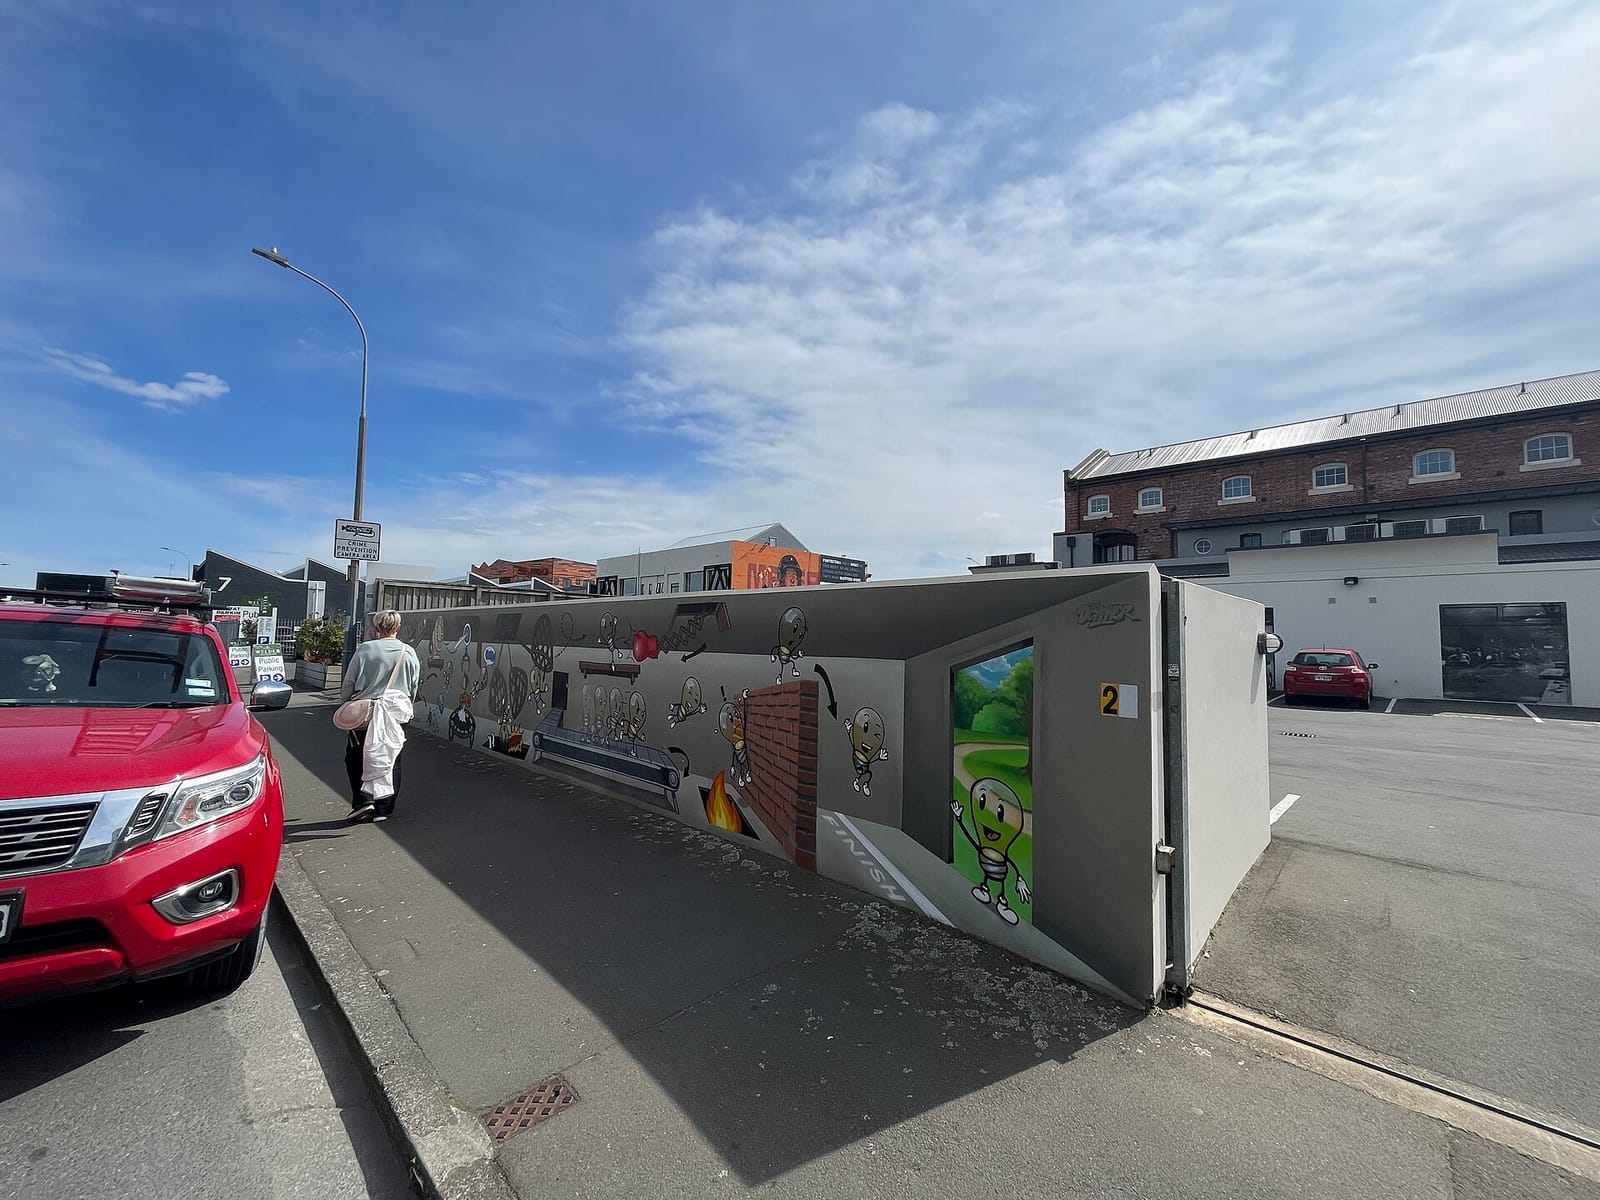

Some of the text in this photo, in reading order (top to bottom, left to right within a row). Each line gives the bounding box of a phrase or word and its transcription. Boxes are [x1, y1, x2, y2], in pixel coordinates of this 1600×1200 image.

[337, 546, 377, 554] PREVENTION
[217, 577, 232, 592] 7
[258, 665, 283, 673] Parking
[1102, 685, 1118, 715] 2
[820, 813, 906, 904] FINISH
